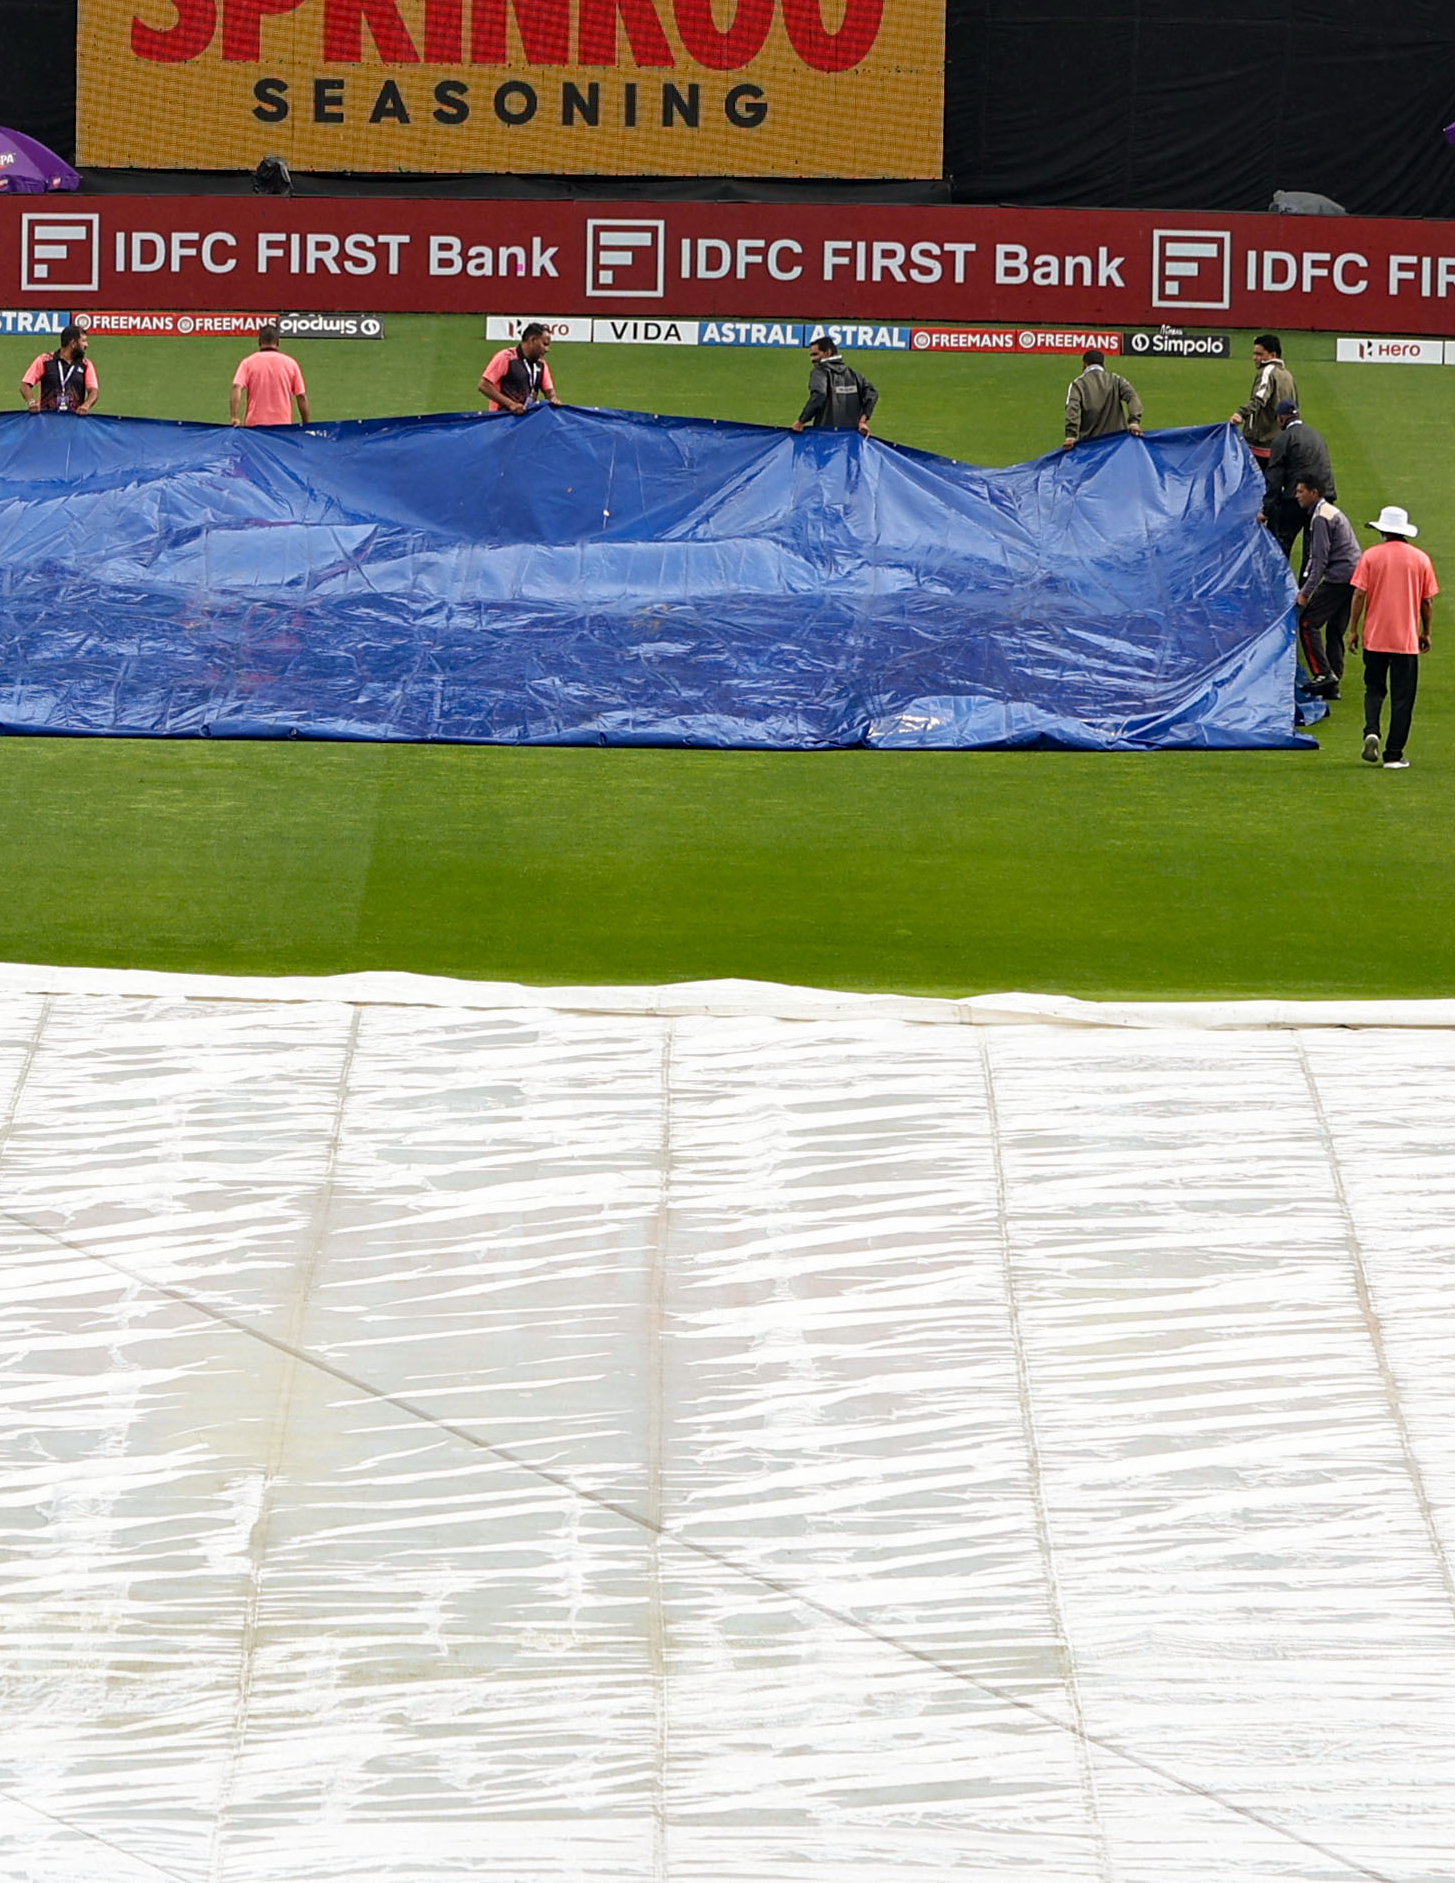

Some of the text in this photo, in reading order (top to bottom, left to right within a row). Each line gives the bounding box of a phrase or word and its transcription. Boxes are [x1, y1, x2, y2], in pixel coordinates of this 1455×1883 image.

[252, 78, 768, 129] SEASONING
[115, 231, 560, 278] IDFC FIRST Bank
[681, 237, 1125, 288] IDFC FIRST Bank
[1246, 249, 1368, 295] IDFC
[93, 315, 173, 330] FREEMANS
[195, 317, 277, 331] FREEMANS
[610, 321, 682, 341] VIDA
[702, 322, 799, 345] ASTRAL
[809, 325, 906, 348] ASTRAL
[932, 333, 1013, 349] FREEMANS
[1036, 332, 1118, 349] FREEMANS
[1152, 335, 1223, 356] Simpolo
